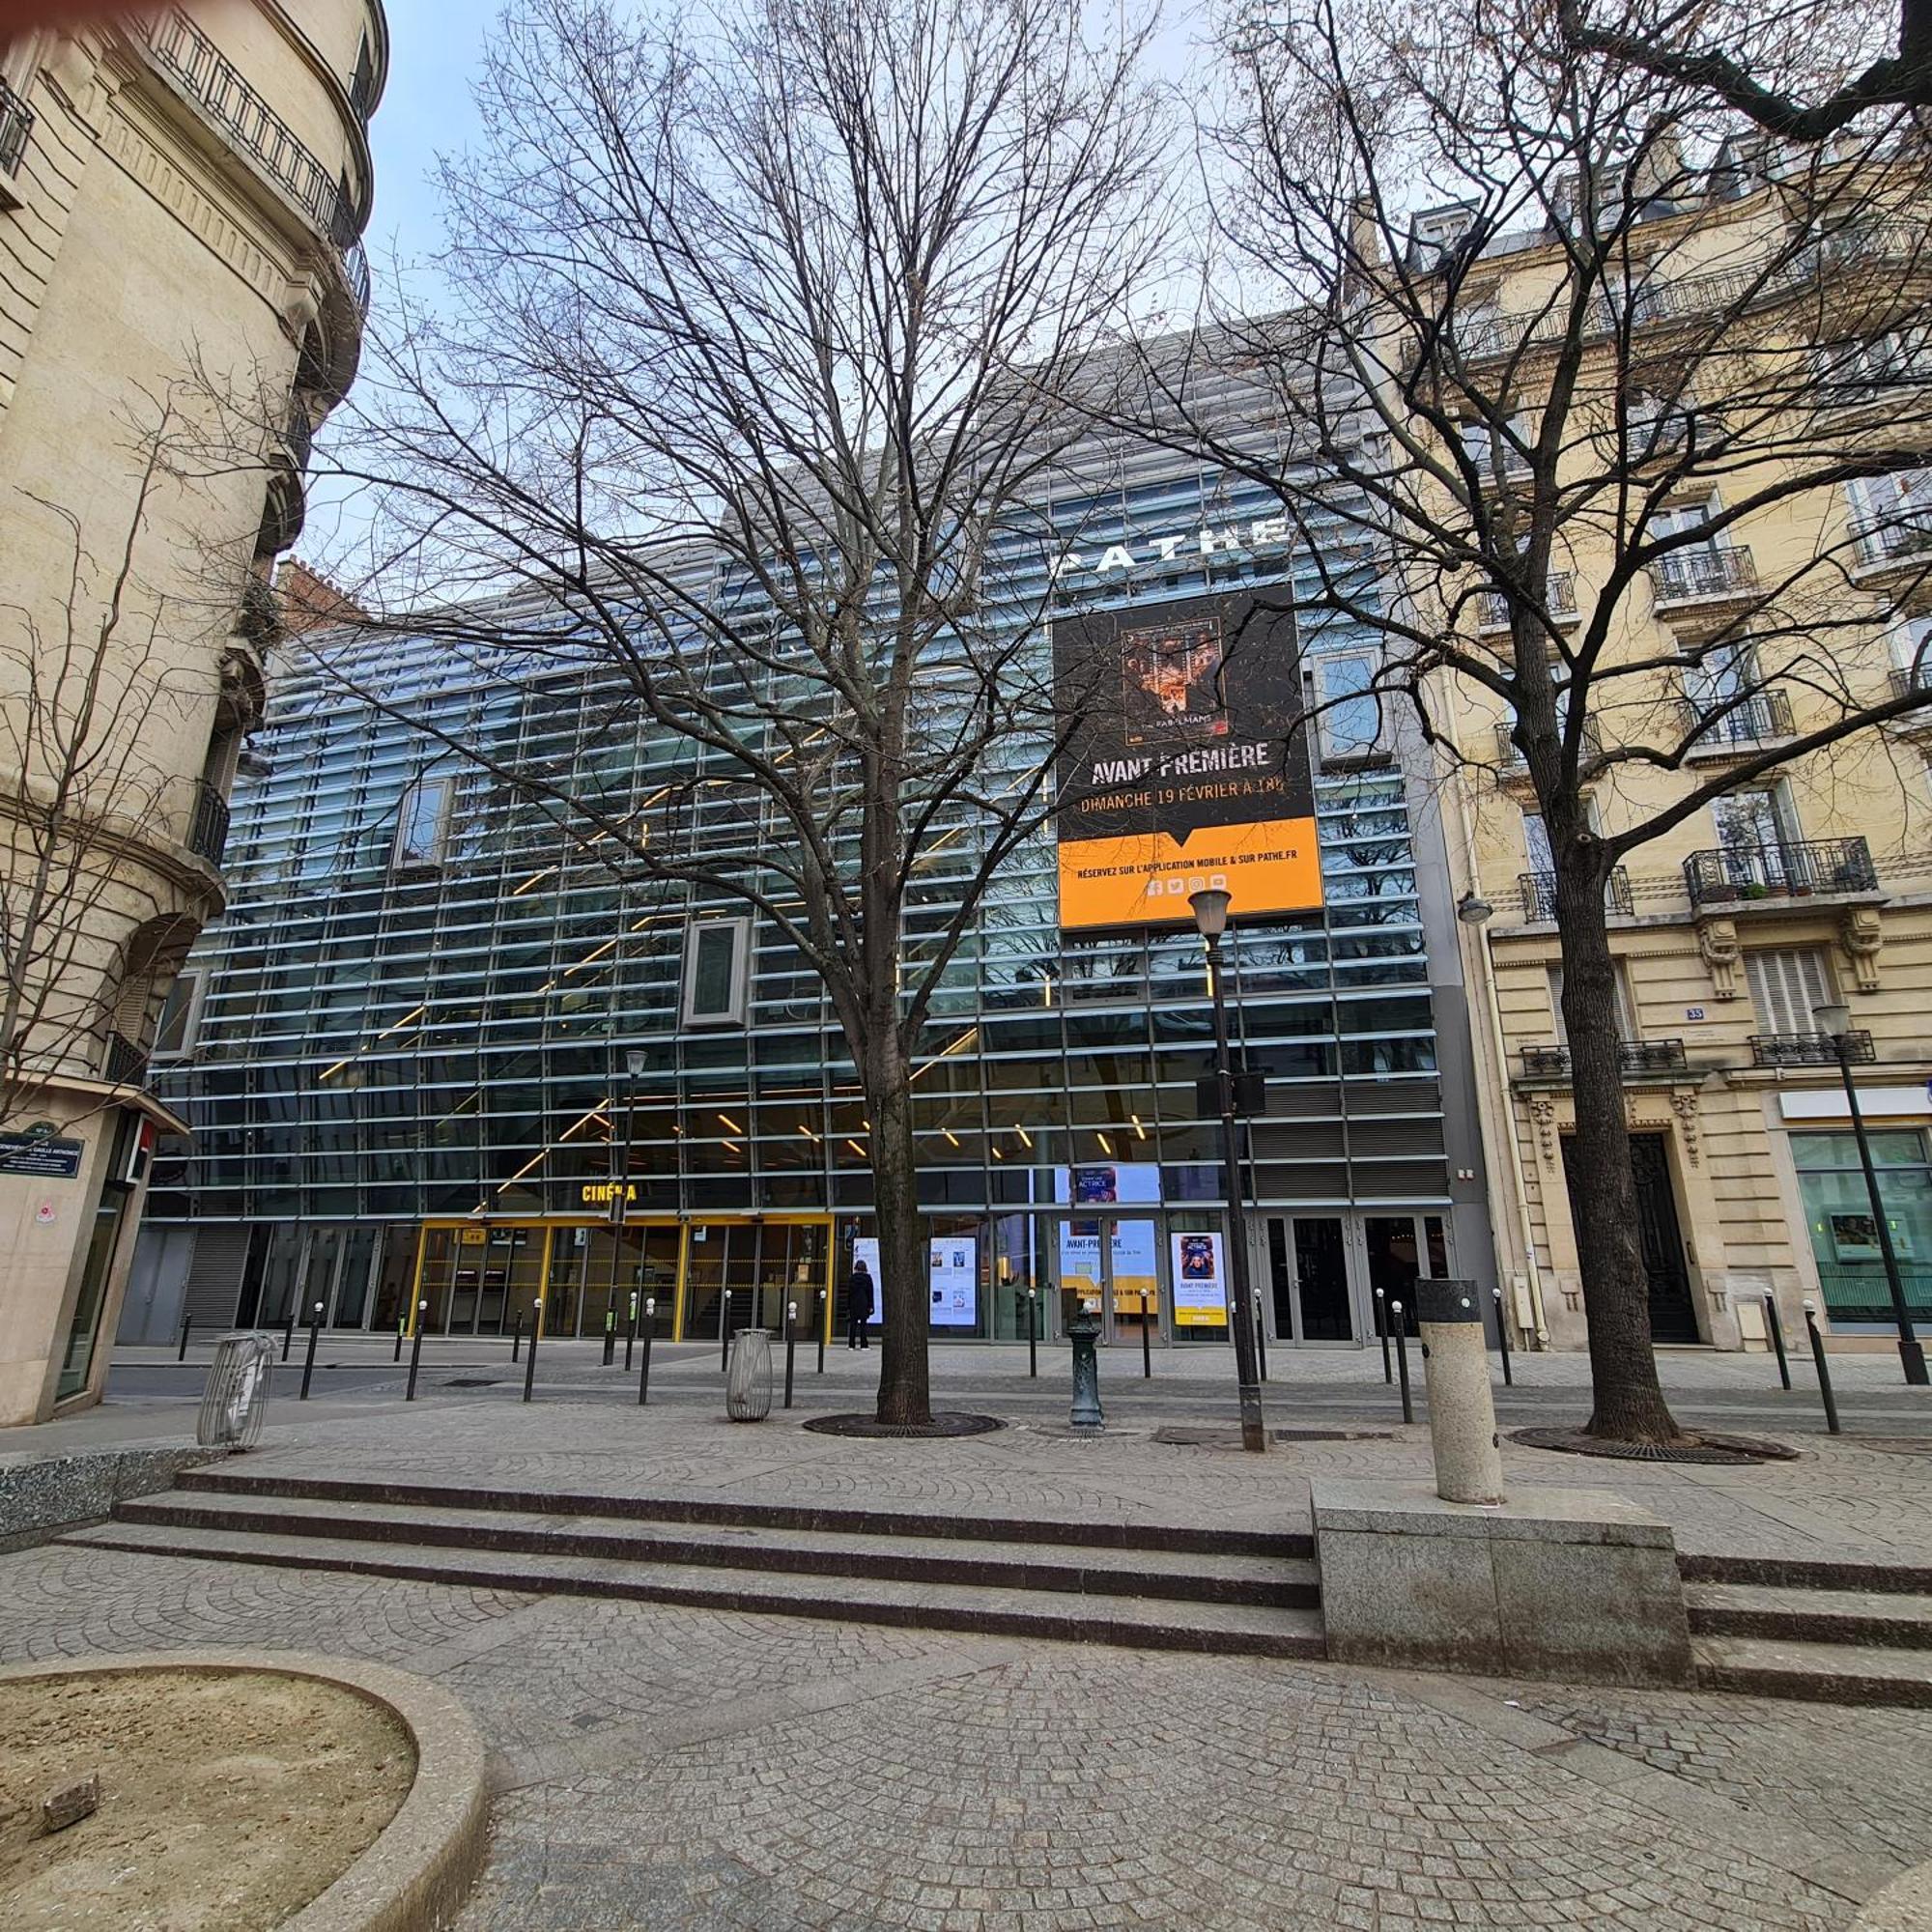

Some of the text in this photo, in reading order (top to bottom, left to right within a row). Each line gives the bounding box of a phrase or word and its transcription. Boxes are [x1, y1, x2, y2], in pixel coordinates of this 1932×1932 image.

[1082, 791, 1152, 812] DIMANCHE
[1158, 788, 1174, 805] 19
[1179, 782, 1237, 802] FÉVRIER
[1077, 867, 1117, 879] RÉSERVEZ
[1119, 865, 1135, 875] SUR
[1136, 860, 1195, 874] L'APPLICATION
[1197, 856, 1228, 867] MOBILE
[1230, 856, 1236, 865] &
[1237, 854, 1256, 865] SUR
[1689, 1009, 1702, 1018] 35
